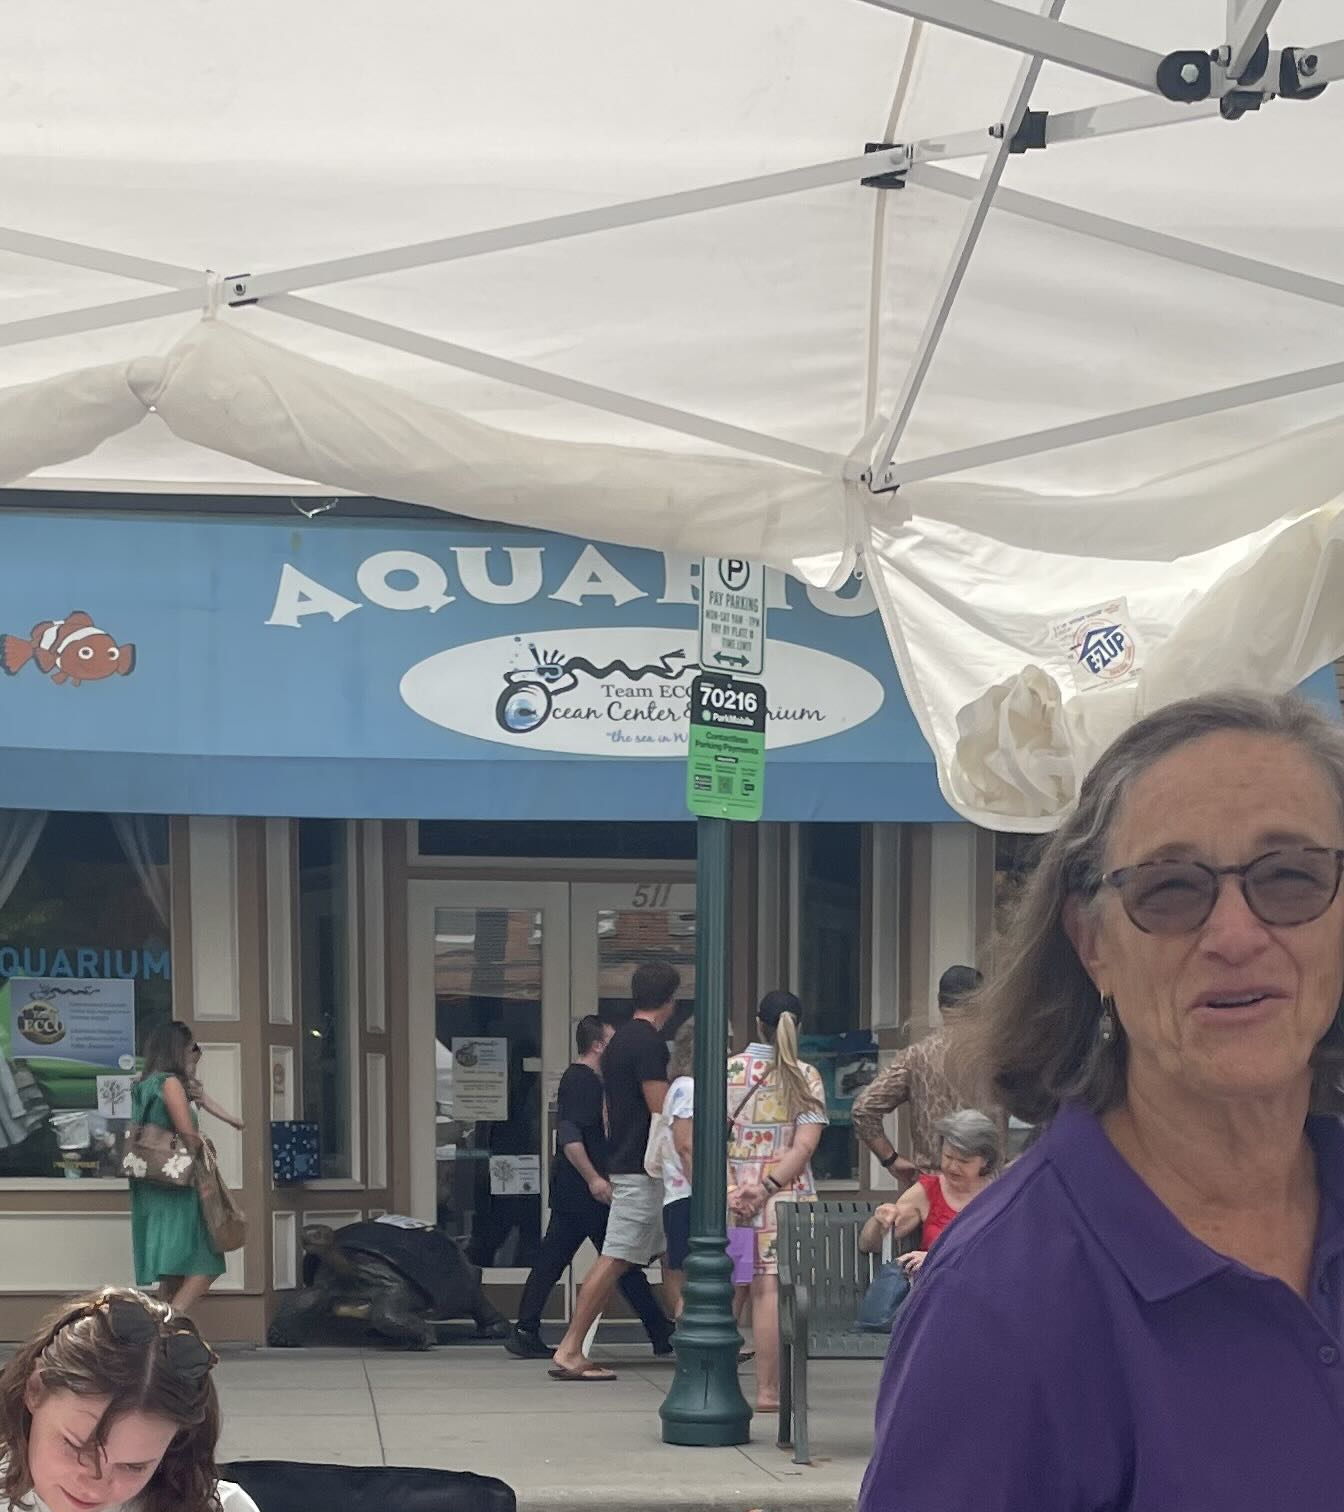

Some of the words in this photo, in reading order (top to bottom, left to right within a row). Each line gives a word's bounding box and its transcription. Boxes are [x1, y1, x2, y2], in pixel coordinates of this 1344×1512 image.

[725, 593, 759, 613] PARKING
[601, 684, 653, 699] Team
[699, 686, 758, 713] 70216
[608, 700, 680, 724] Center
